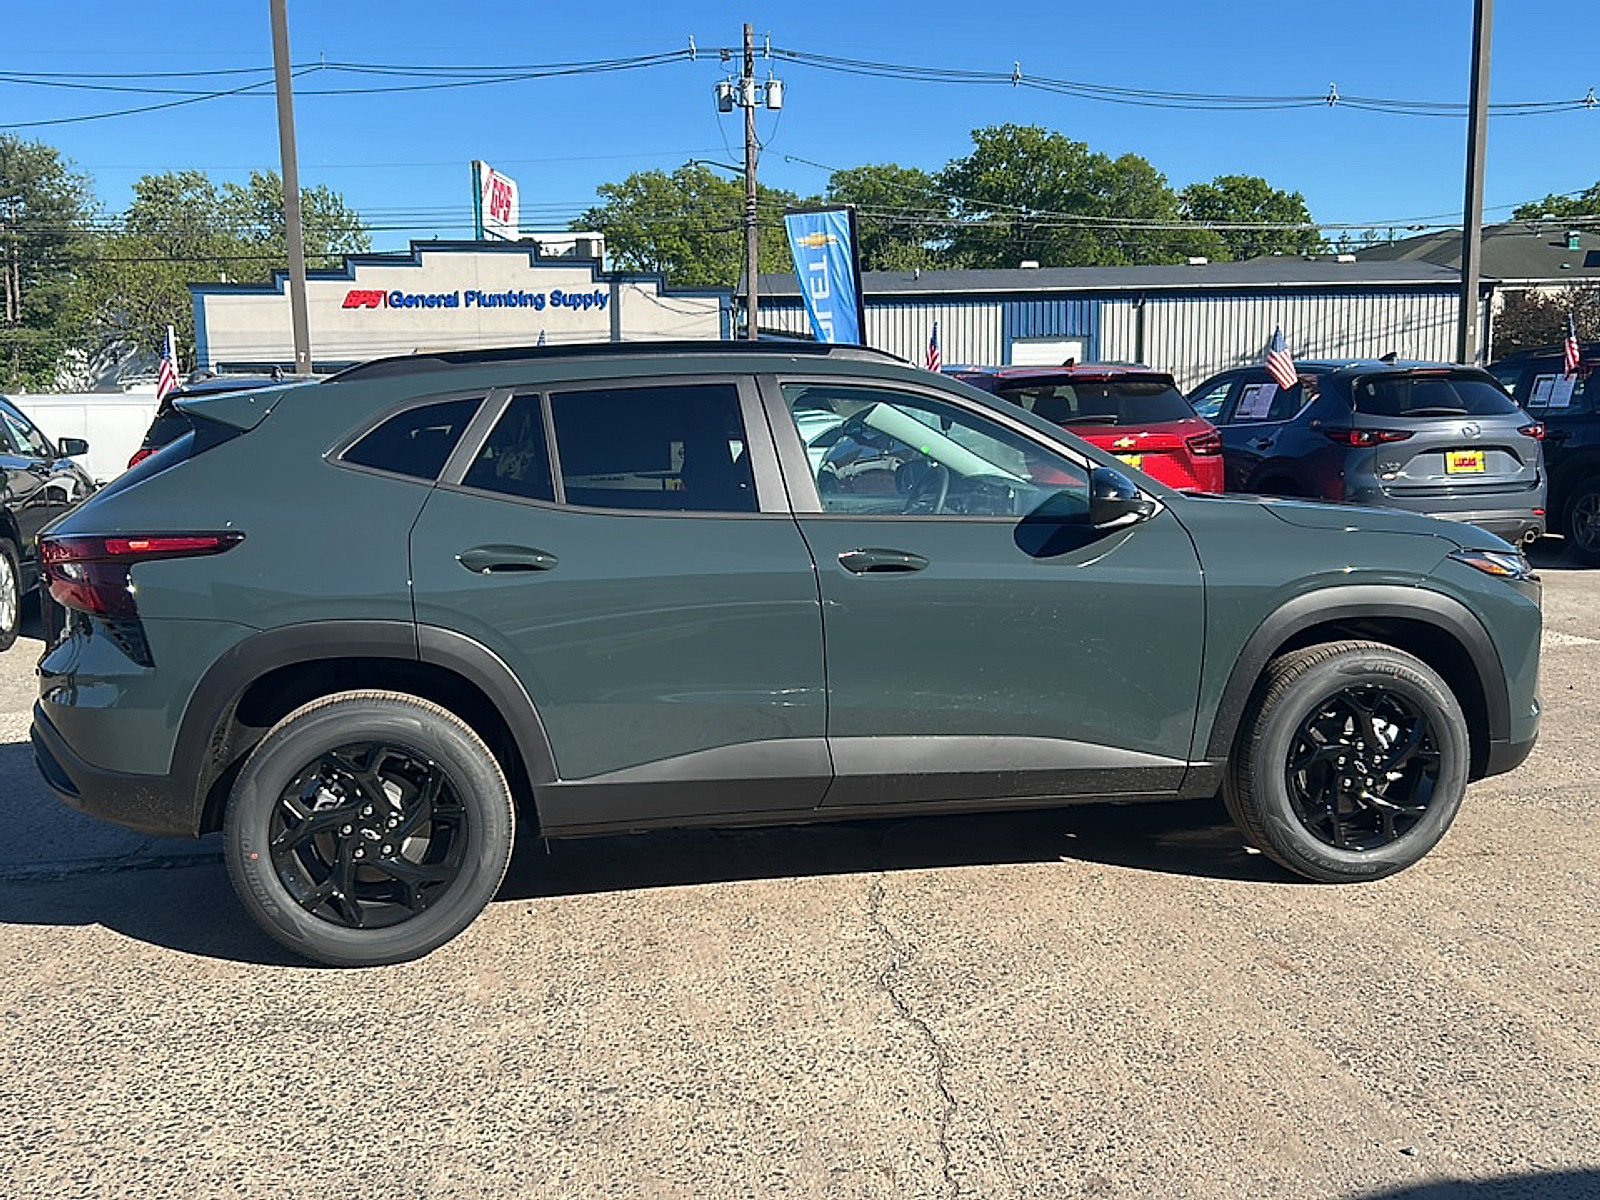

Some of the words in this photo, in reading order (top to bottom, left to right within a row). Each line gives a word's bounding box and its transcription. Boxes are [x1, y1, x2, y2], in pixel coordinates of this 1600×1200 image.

[388, 290, 459, 309] General
[464, 290, 546, 311] Plumbing
[549, 289, 609, 311] Supply
